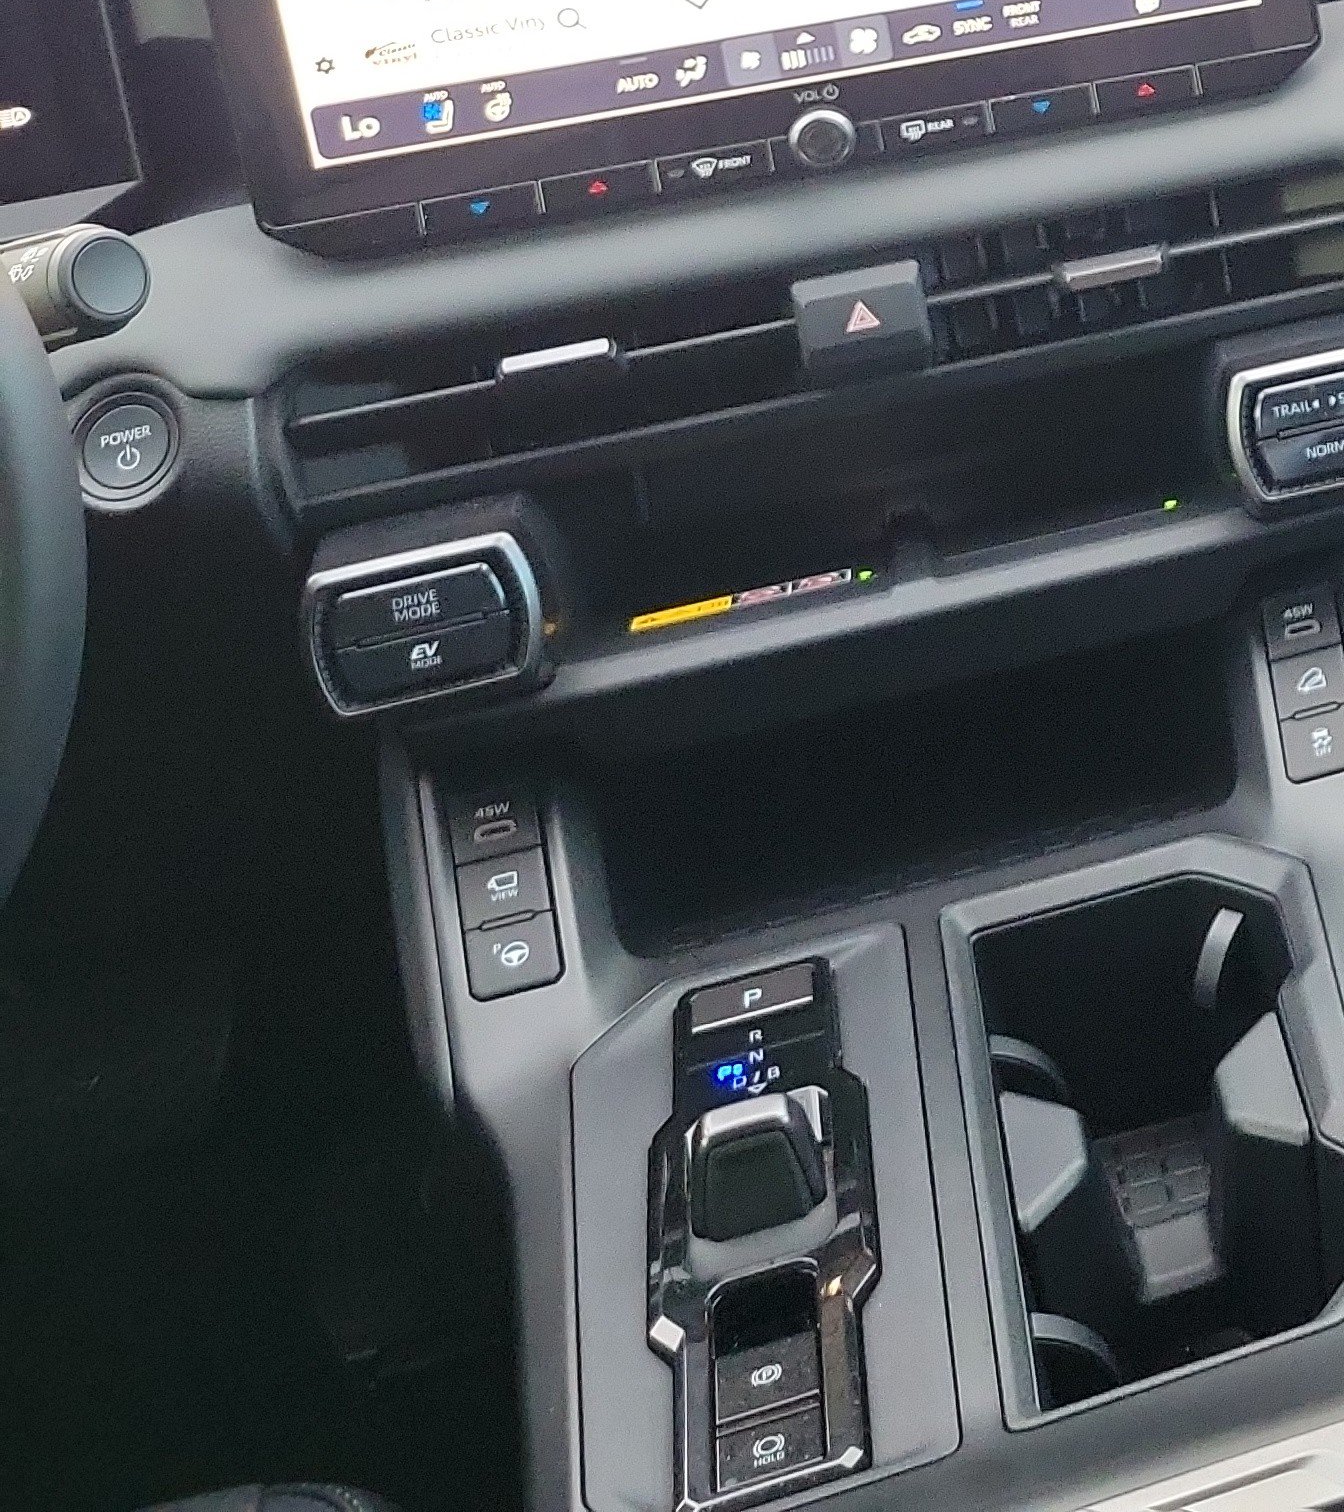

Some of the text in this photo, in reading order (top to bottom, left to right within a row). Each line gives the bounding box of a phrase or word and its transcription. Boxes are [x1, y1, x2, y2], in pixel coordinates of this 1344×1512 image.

[430, 22, 502, 44] Classic
[952, 15, 994, 37] SYNC
[616, 72, 660, 94] AUTO
[793, 87, 821, 103] VOL
[927, 118, 954, 133] REAR
[718, 155, 752, 170] FRONT
[1272, 399, 1312, 418] TRAIL
[100, 424, 153, 448] POWER
[392, 588, 439, 610] DRIVE
[394, 600, 441, 622] MODE
[409, 640, 440, 661] EV
[490, 888, 519, 902] VIEW
[743, 987, 763, 1009] P
[749, 1048, 764, 1064] N
[753, 1450, 786, 1468] HOLD
